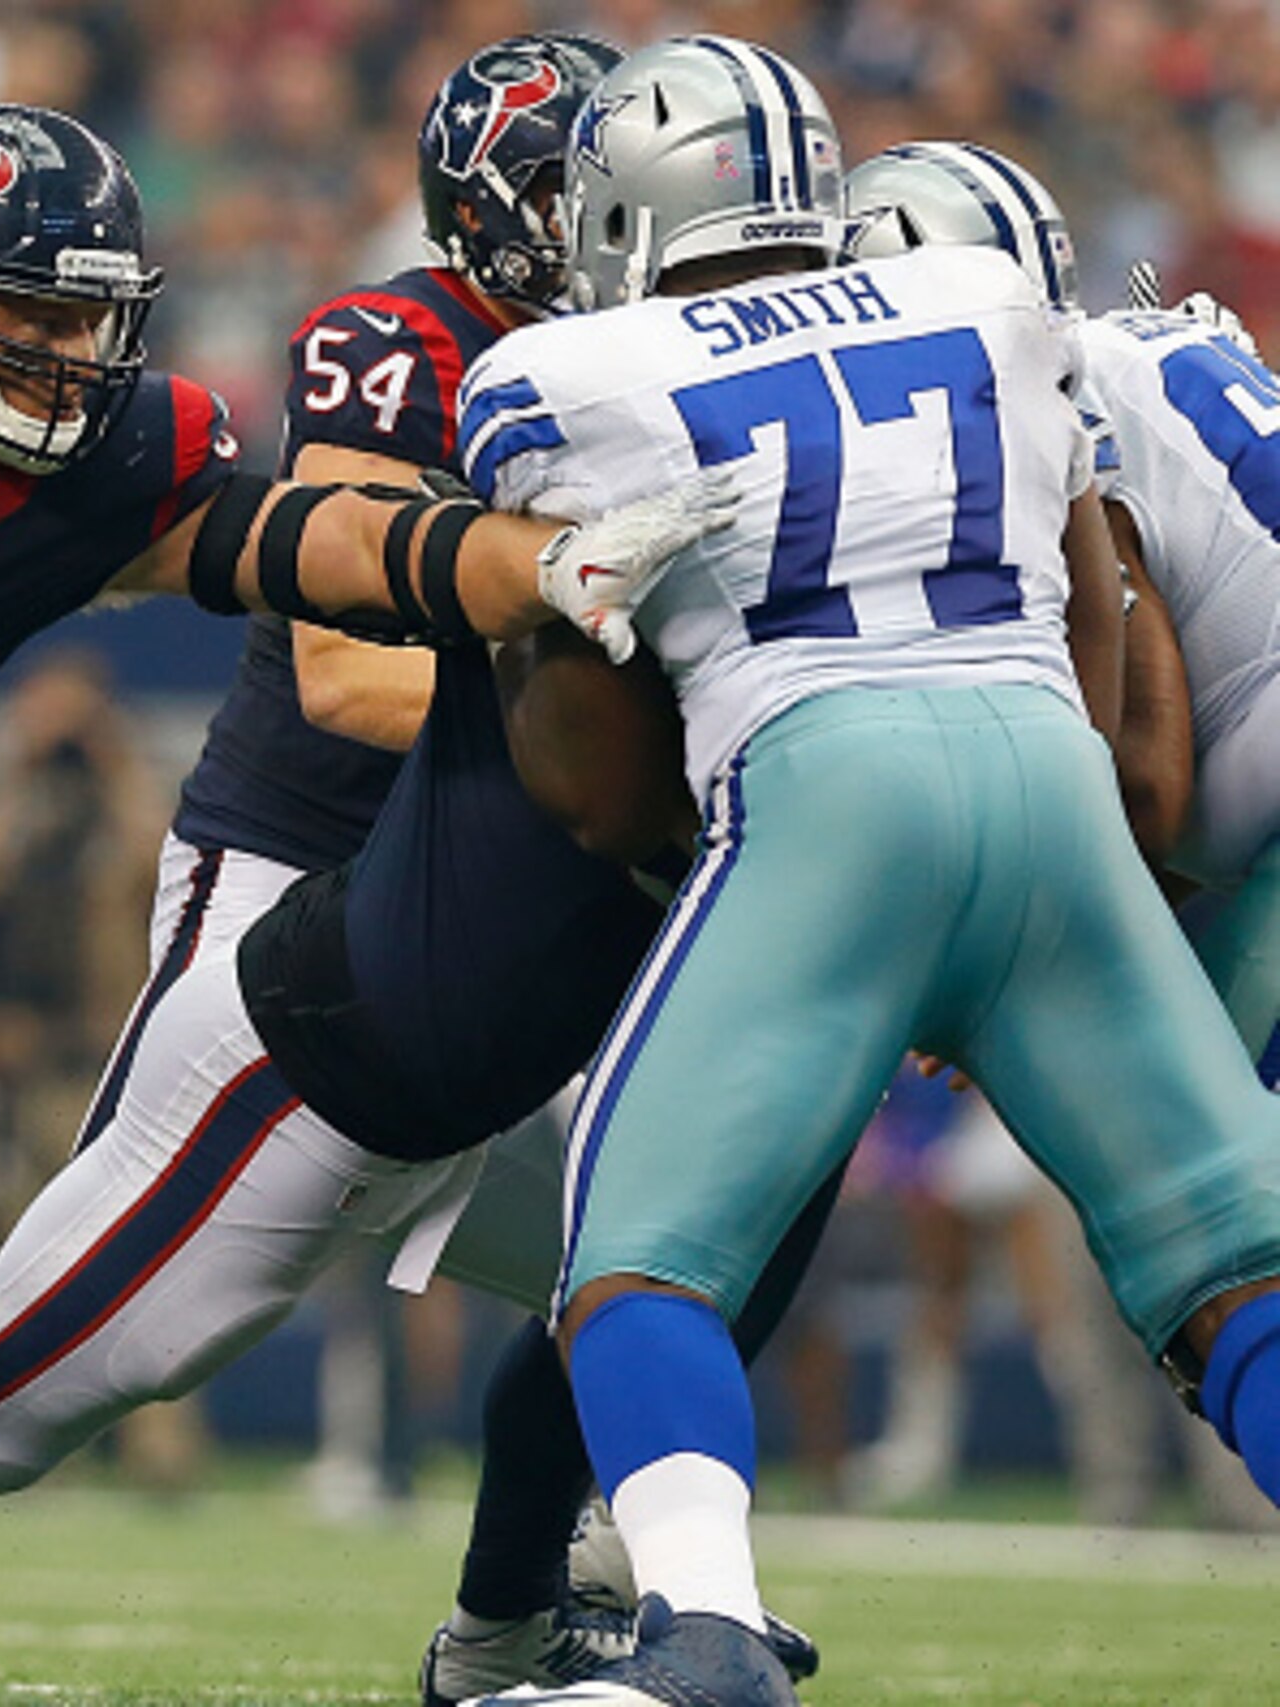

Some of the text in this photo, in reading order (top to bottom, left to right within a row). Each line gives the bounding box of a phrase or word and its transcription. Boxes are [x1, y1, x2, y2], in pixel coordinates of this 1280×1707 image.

[680, 272, 901, 357] SMITH
[303, 326, 418, 436] 54
[668, 326, 1027, 646] 77
